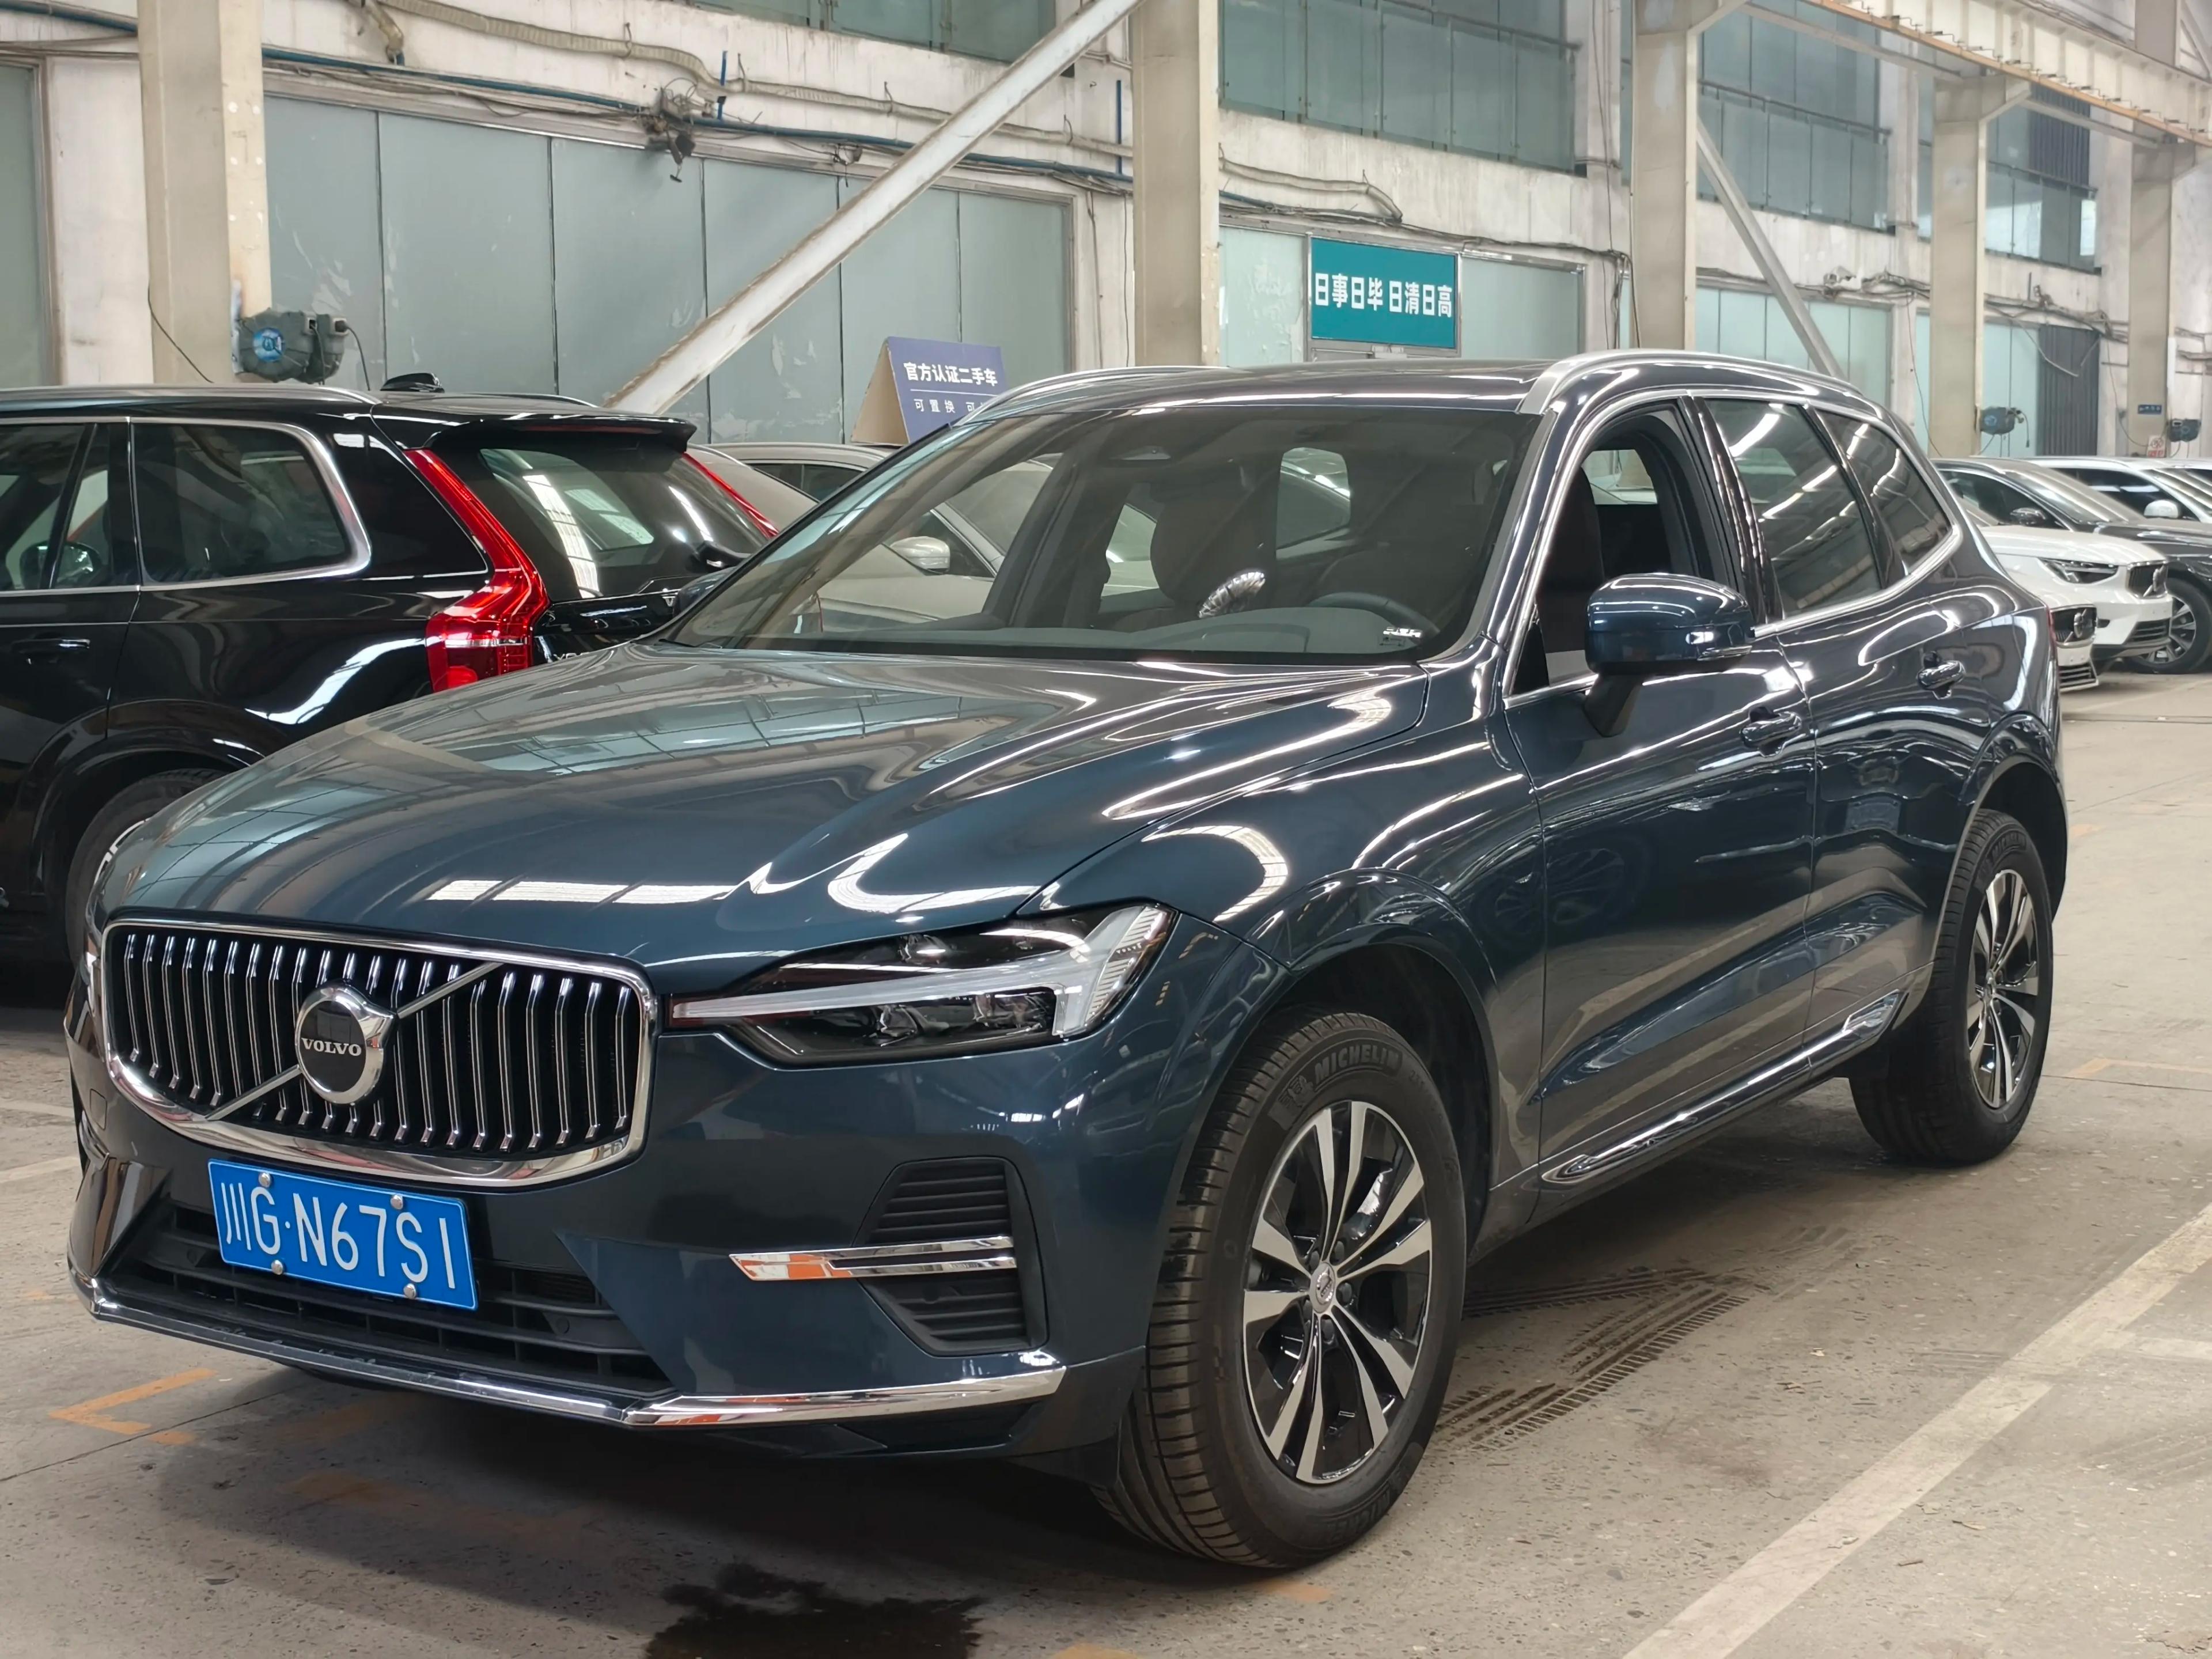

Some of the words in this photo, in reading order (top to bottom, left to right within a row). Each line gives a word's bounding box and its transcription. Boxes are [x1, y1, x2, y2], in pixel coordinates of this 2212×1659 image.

[1315, 272, 1383, 311] 日事日毕
[1389, 281, 1452, 318] 日清日高
[903, 362, 998, 387] 官方认证二手车
[914, 399, 956, 414] 可置换
[301, 1037, 362, 1056] VOLVO
[1315, 1044, 1399, 1085] MICHELIN
[221, 1182, 456, 1290] 川G·N67S1
